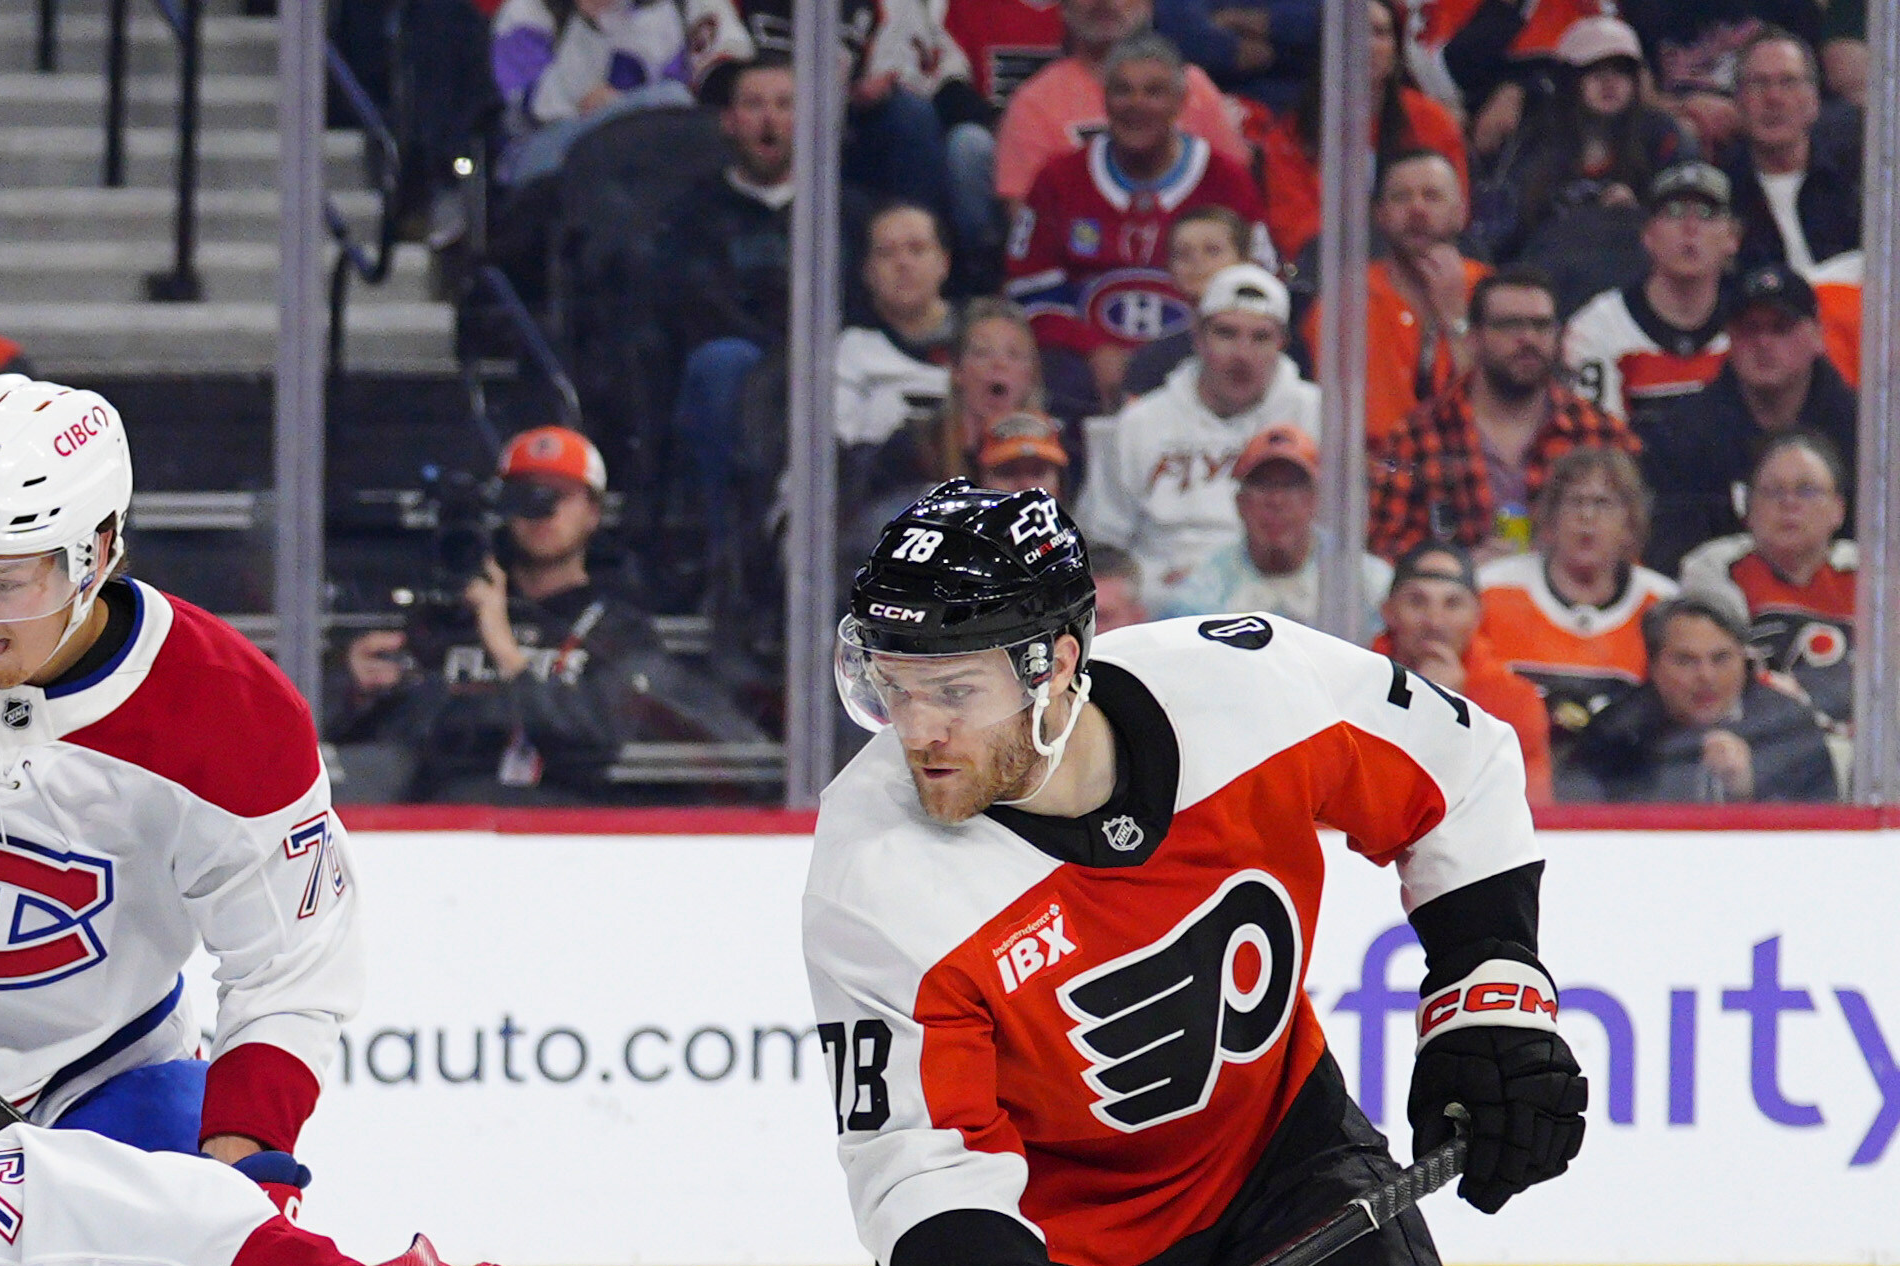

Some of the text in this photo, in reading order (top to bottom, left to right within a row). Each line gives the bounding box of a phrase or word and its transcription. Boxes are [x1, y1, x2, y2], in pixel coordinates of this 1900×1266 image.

[53, 415, 97, 456] CIBC
[892, 528, 944, 563] 78
[868, 603, 926, 623] CCM
[992, 911, 1050, 958] Independence
[996, 914, 1077, 995] IBX
[1420, 982, 1559, 1037] CCM
